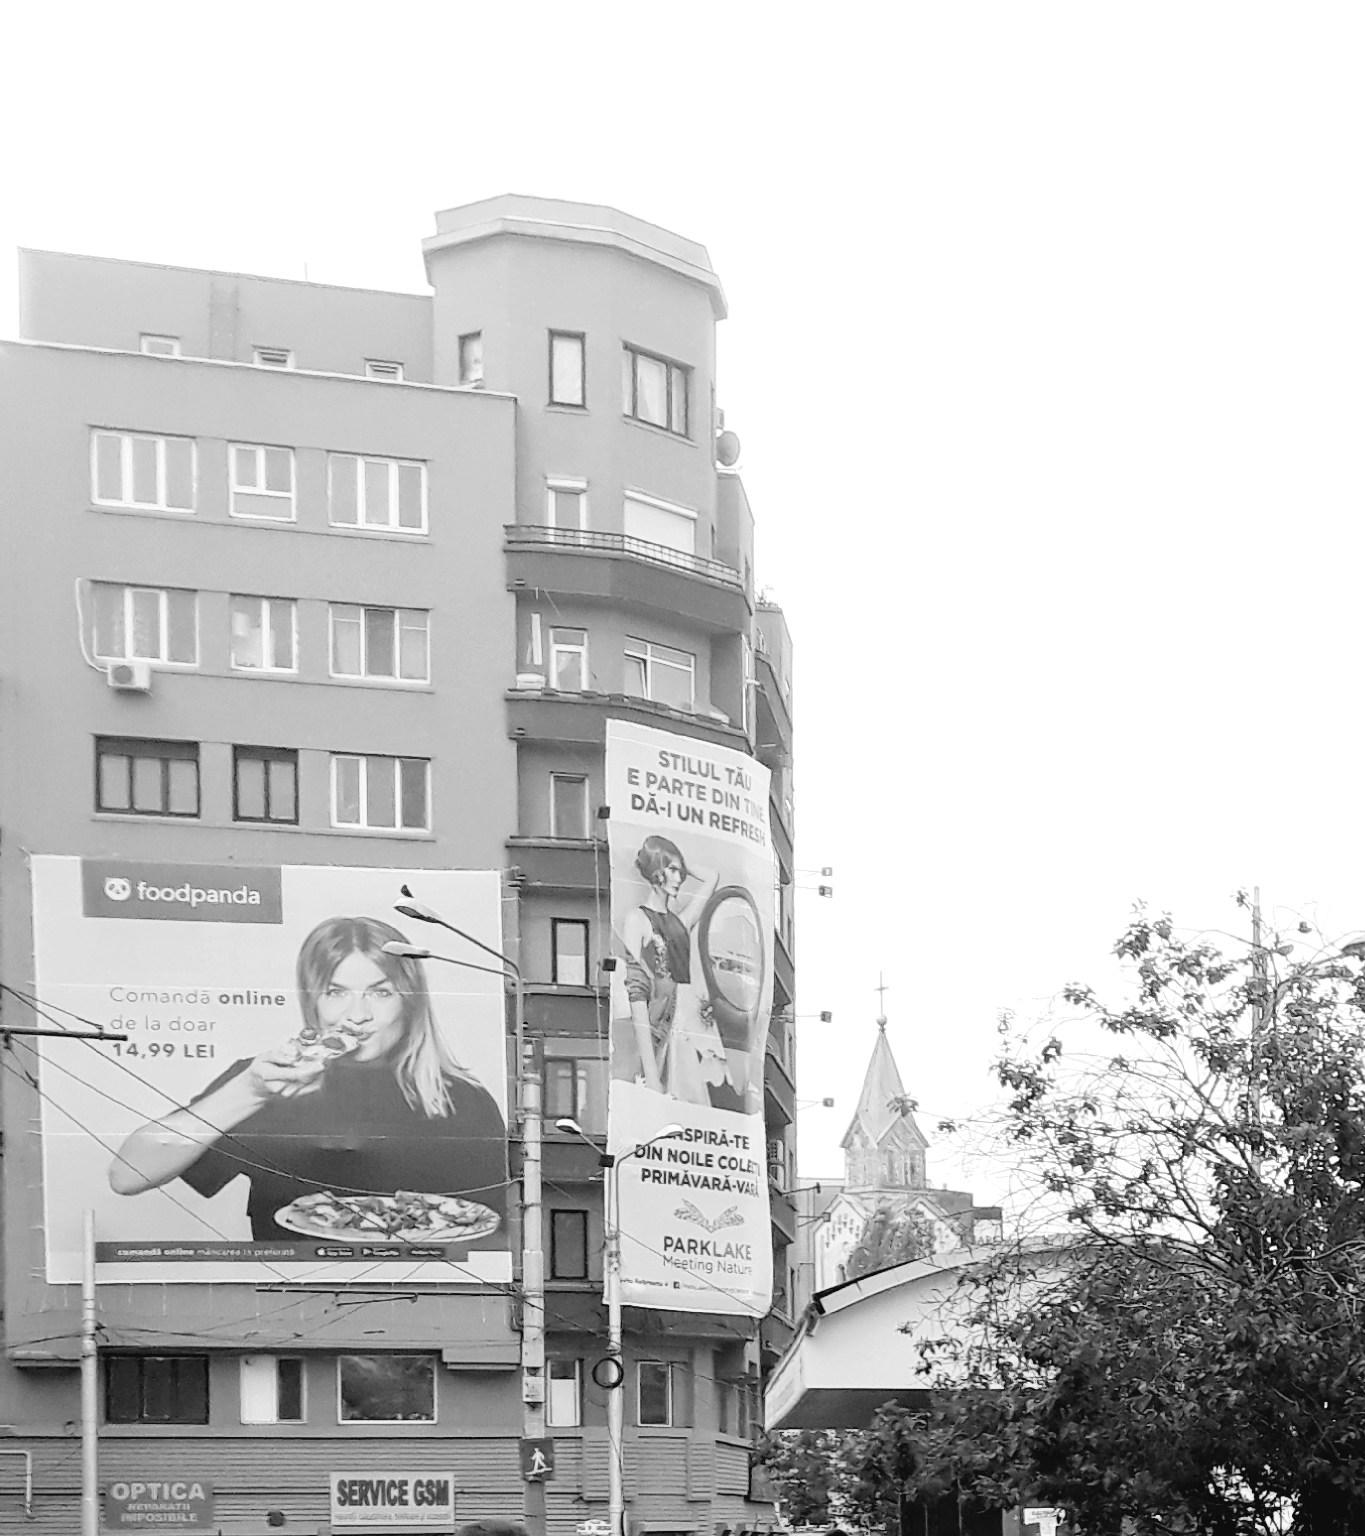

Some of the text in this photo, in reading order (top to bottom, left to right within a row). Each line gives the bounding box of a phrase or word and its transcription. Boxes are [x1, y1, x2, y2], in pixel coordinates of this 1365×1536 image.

[658, 750, 752, 791] STILUL TĂU
[627, 767, 639, 786] E
[645, 772, 707, 802] PARTE
[712, 789, 740, 812] DIN
[631, 793, 766, 847] DĂ-I UN REFRESH
[137, 881, 261, 908] foodpanda
[219, 990, 286, 1006] online
[110, 1015, 217, 1032] de la doar
[112, 1043, 215, 1060] 14,99 LEI
[672, 1127, 750, 1151] SPIRĂ-TE
[634, 1143, 663, 1161] DIN
[667, 1149, 713, 1168] NOILE
[663, 1236, 752, 1261] PARKLAKE
[662, 1254, 713, 1274] Meeting
[111, 1482, 206, 1500] OPTICA
[336, 1479, 450, 1506] SERVICE GSM
